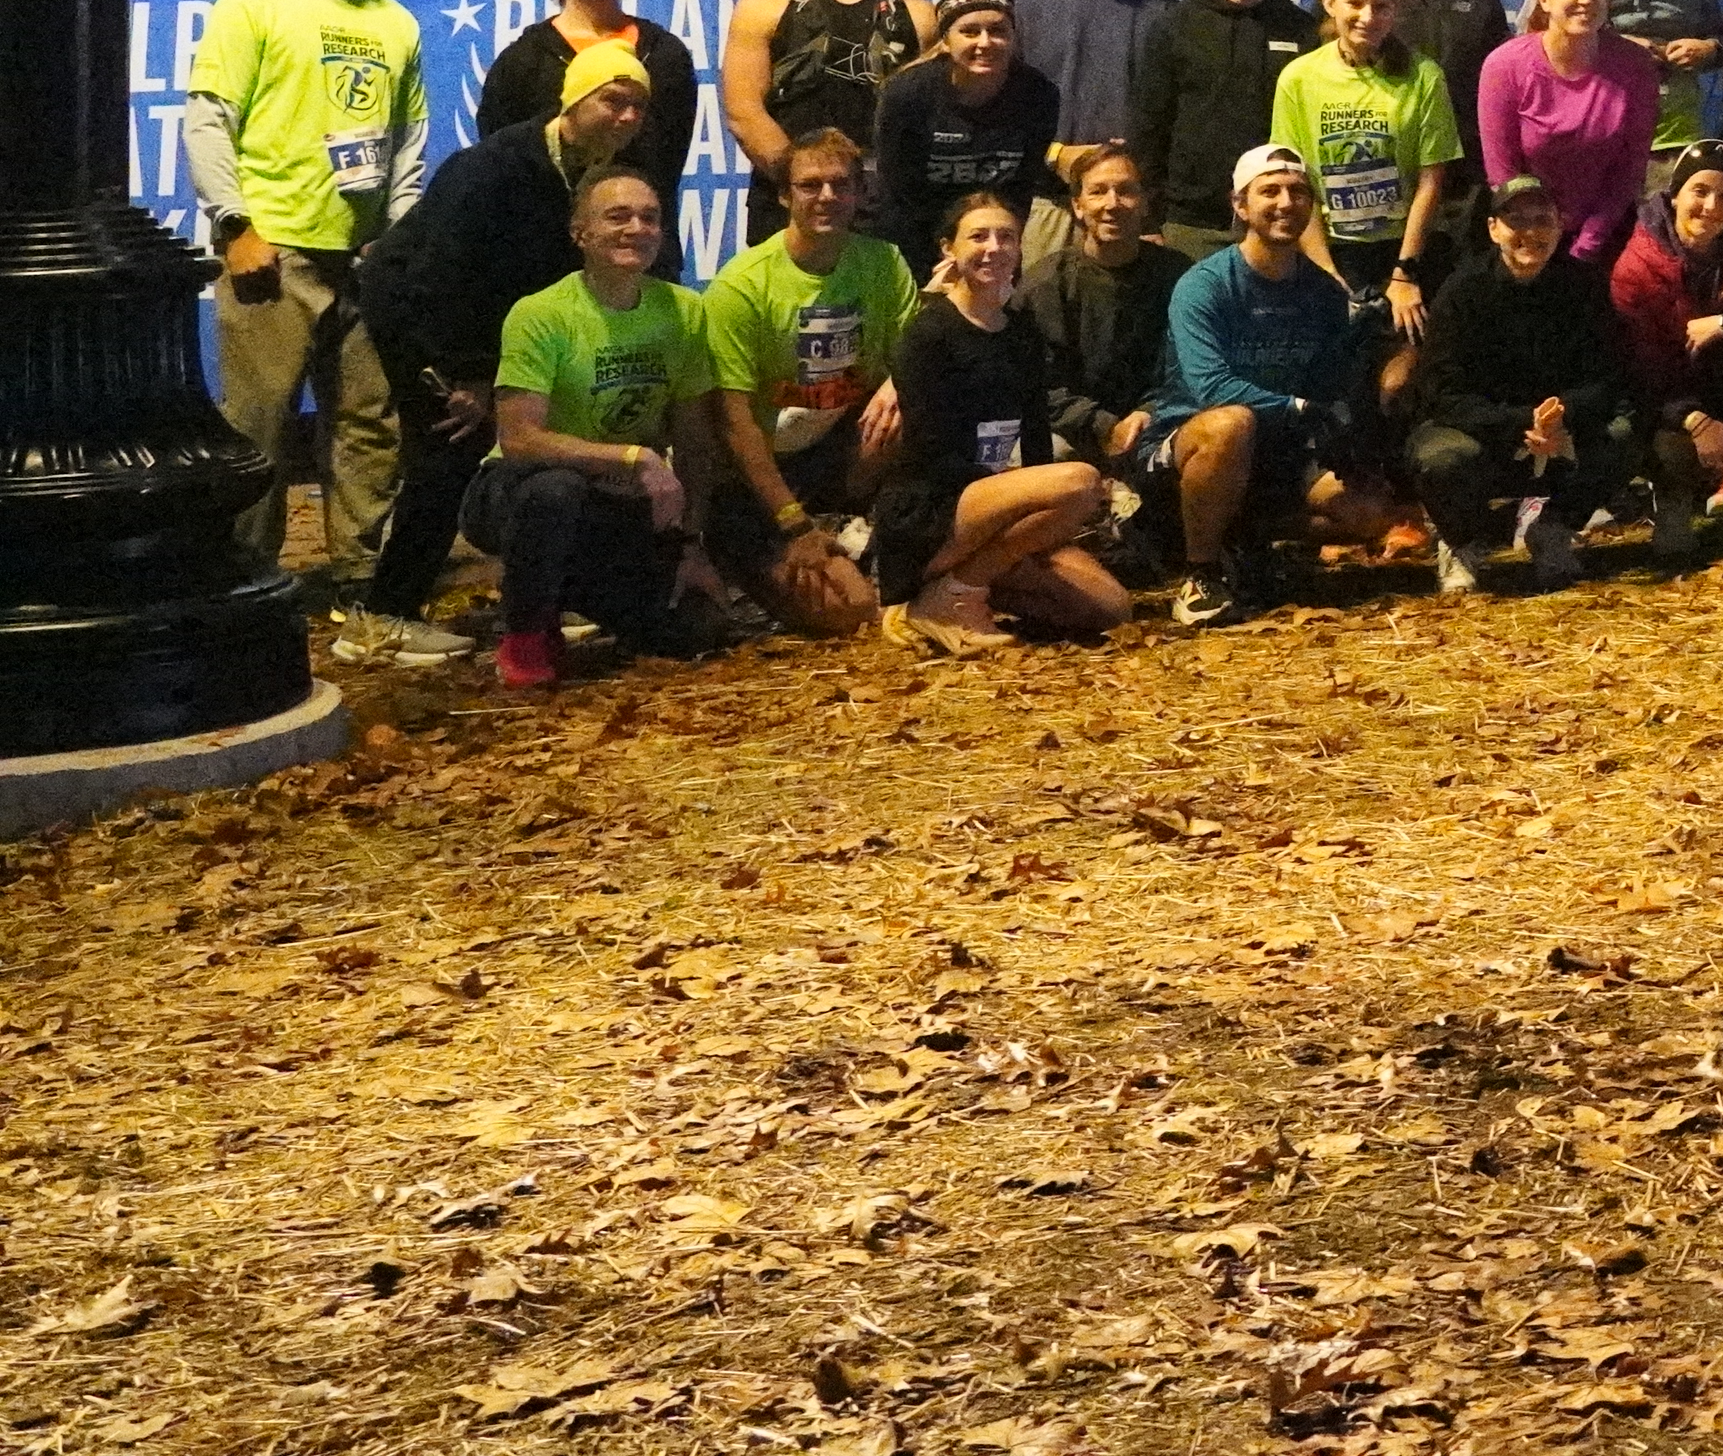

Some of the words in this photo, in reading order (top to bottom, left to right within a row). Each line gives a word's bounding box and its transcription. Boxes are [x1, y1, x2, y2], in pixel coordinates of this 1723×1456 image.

[320, 31, 370, 47] RUNNERS
[322, 43, 386, 62] RESEARCH
[1320, 110, 1374, 123] RUNNERS
[1320, 120, 1389, 136] RESEARCH
[338, 151, 352, 170] F
[1331, 194, 1344, 210] G
[1347, 186, 1398, 209] 10023
[811, 340, 822, 358] C
[595, 364, 667, 385] RESEARCH
